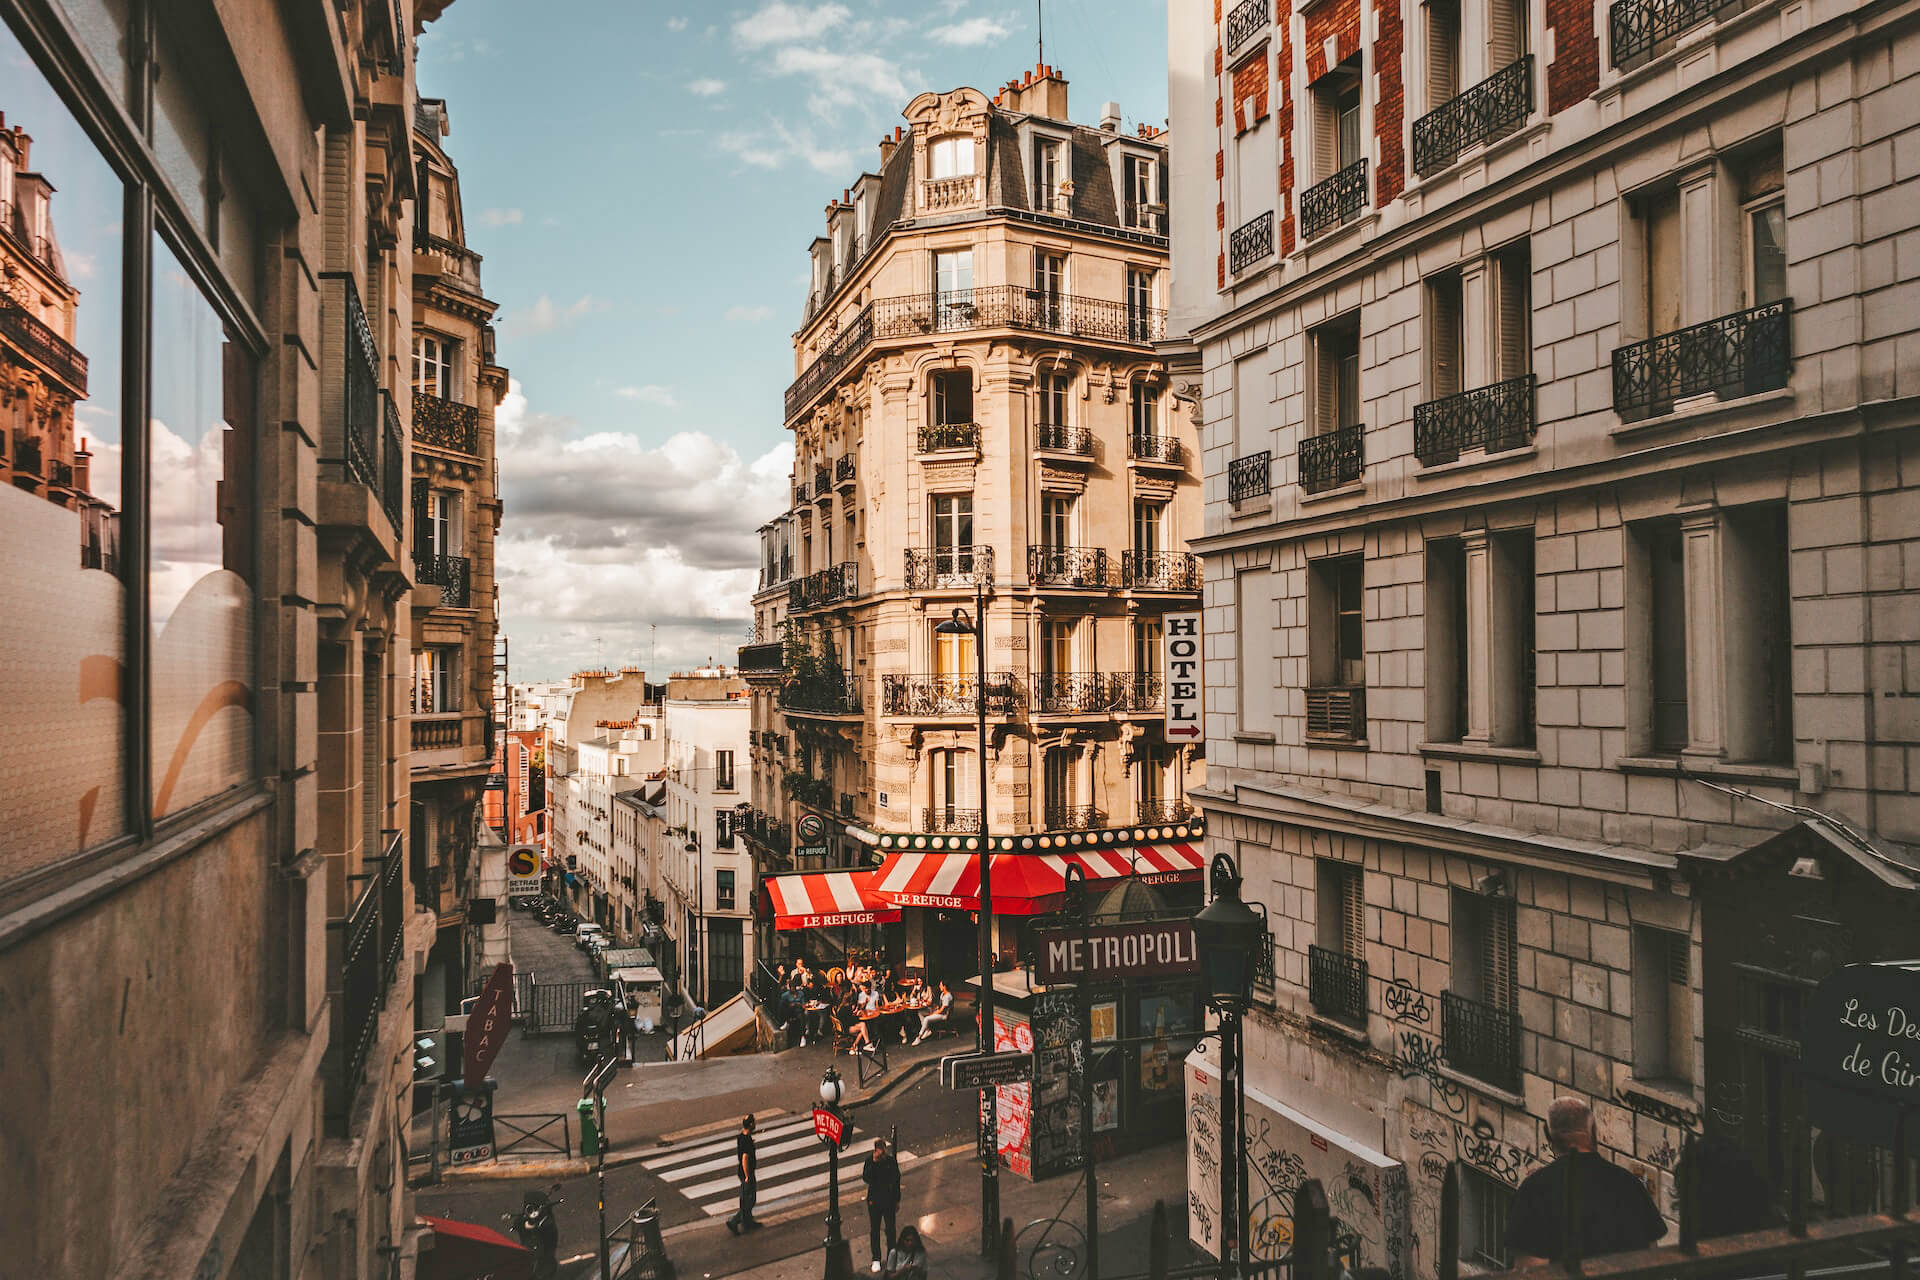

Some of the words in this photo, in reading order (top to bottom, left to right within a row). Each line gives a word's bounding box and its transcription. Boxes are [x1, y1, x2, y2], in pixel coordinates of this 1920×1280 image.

[1168, 618, 1197, 721] HOTEL
[1141, 873, 1180, 885] REFUGE
[894, 894, 910, 904] LE
[912, 895, 962, 908] REFUGE
[803, 916, 821, 927] LE
[823, 913, 874, 926] REFUGE
[1048, 929, 1198, 974] METROPOLI
[476, 988, 504, 1062] TABAC
[1840, 998, 1879, 1031] Les
[1842, 1042, 1873, 1077] de
[816, 1113, 840, 1134] METRO
